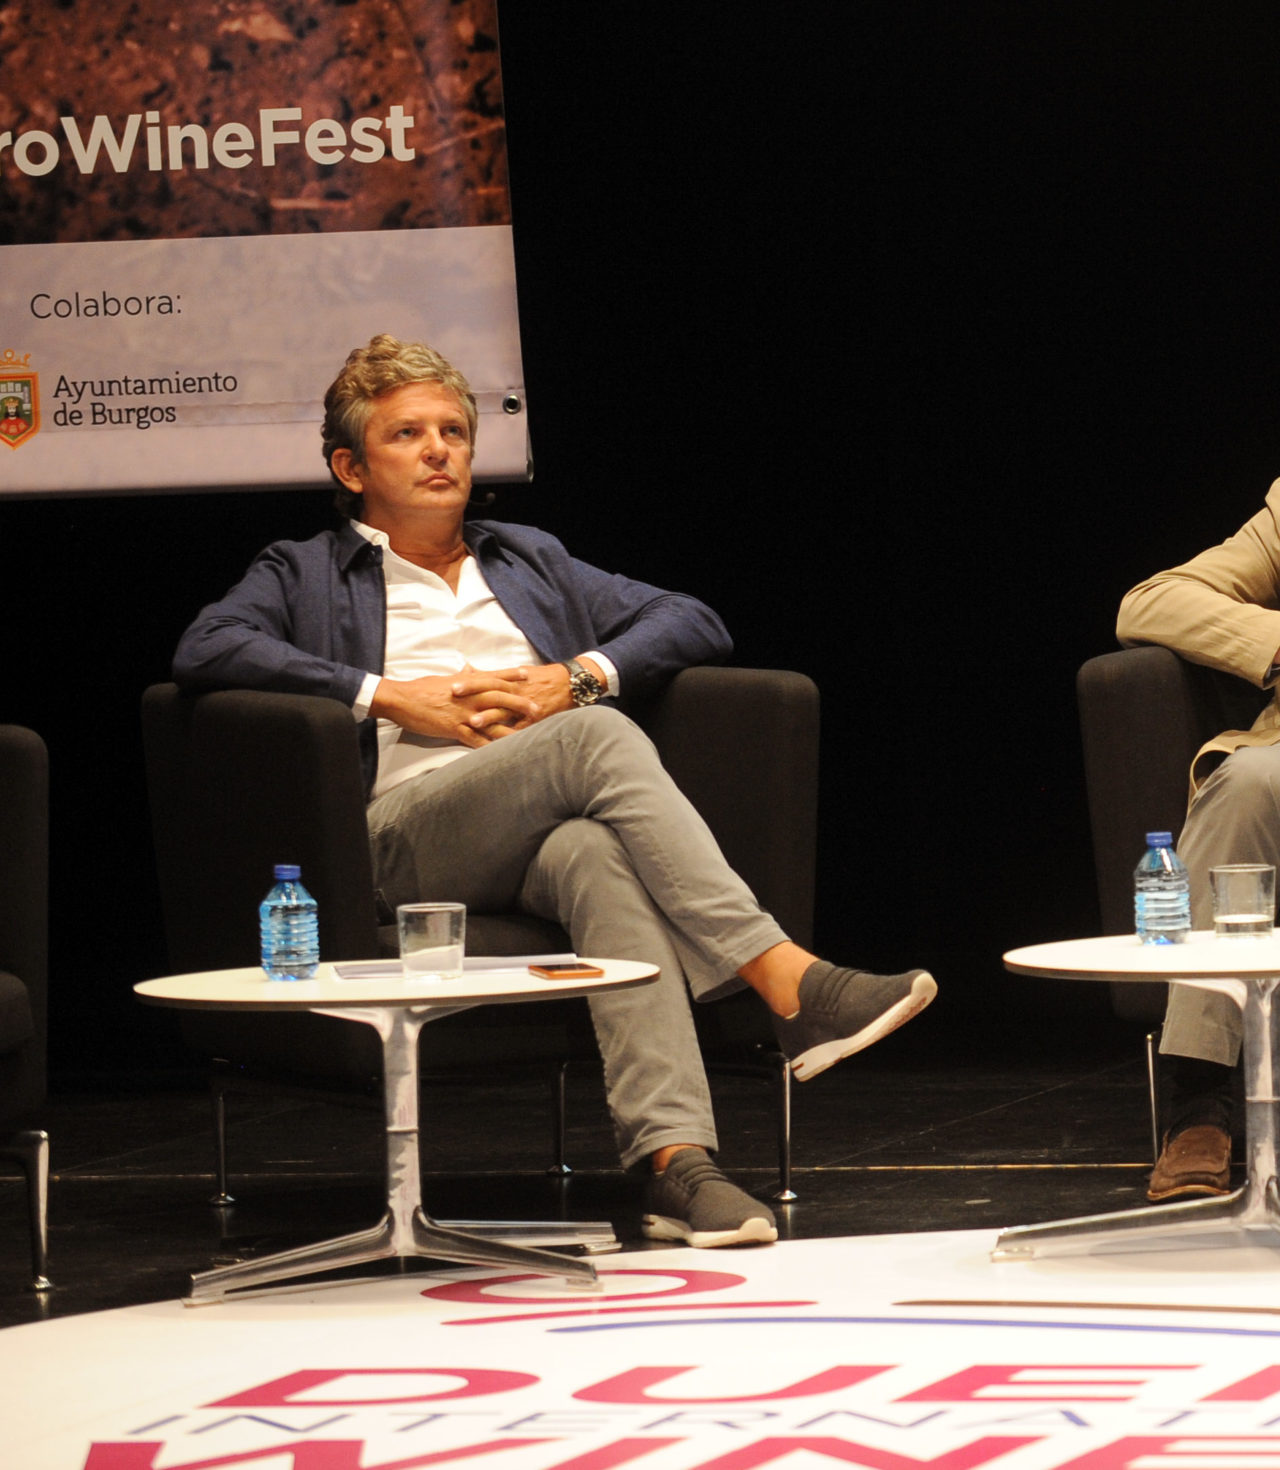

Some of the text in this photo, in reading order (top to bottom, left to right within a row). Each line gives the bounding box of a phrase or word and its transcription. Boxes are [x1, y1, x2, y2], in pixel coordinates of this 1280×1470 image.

[30, 290, 182, 319] Colabora:
[52, 370, 238, 405] Ayuntamiento
[53, 401, 177, 430] de Burgos
